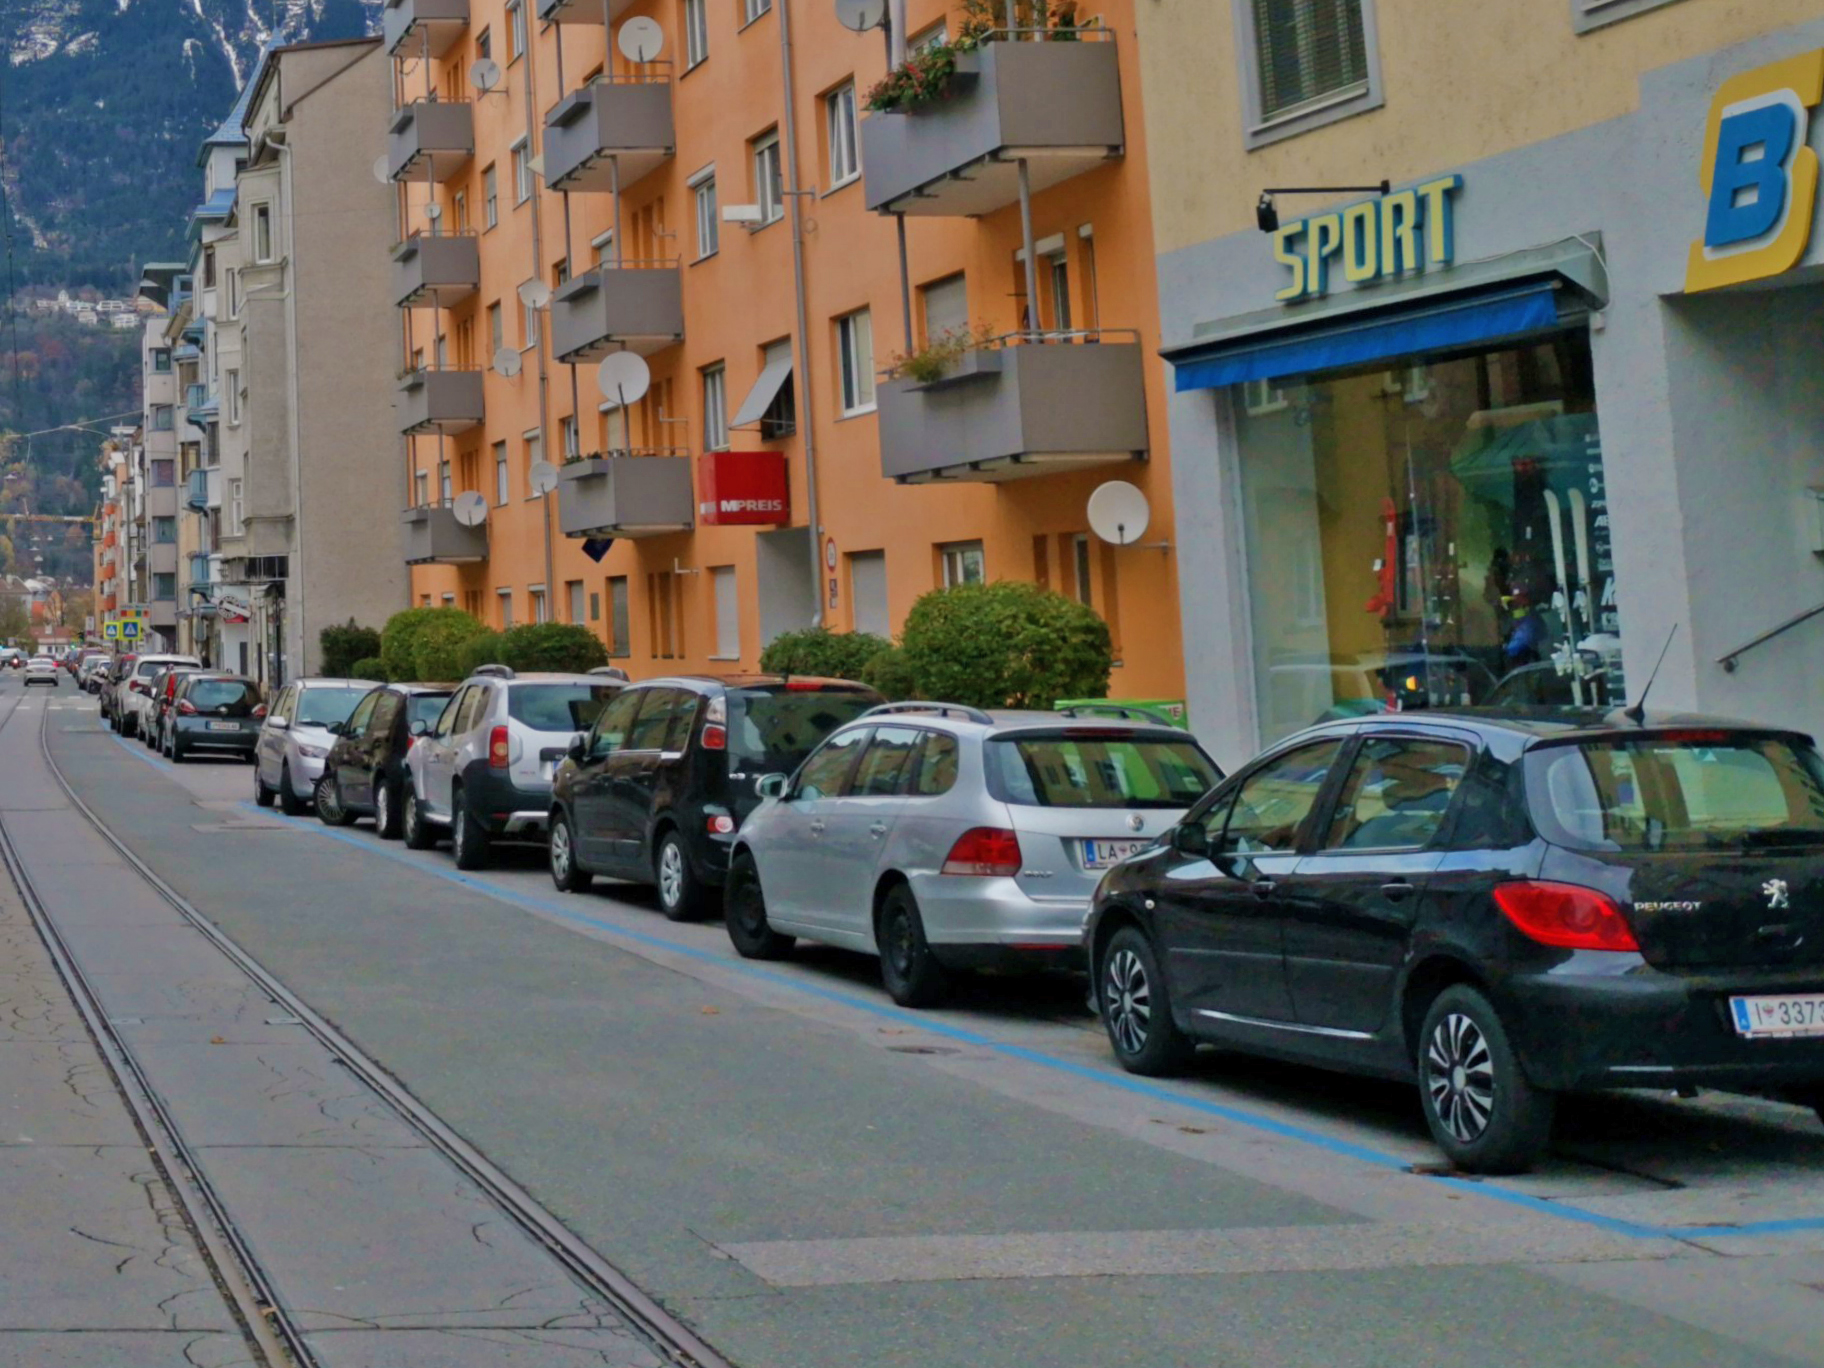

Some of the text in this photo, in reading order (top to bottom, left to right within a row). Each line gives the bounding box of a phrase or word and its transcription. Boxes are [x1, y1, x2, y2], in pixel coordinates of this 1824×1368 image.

[1274, 174, 1460, 301] SPORT
[720, 499, 782, 511] MPREIS
[1634, 901, 1701, 911] PEUGEOT
